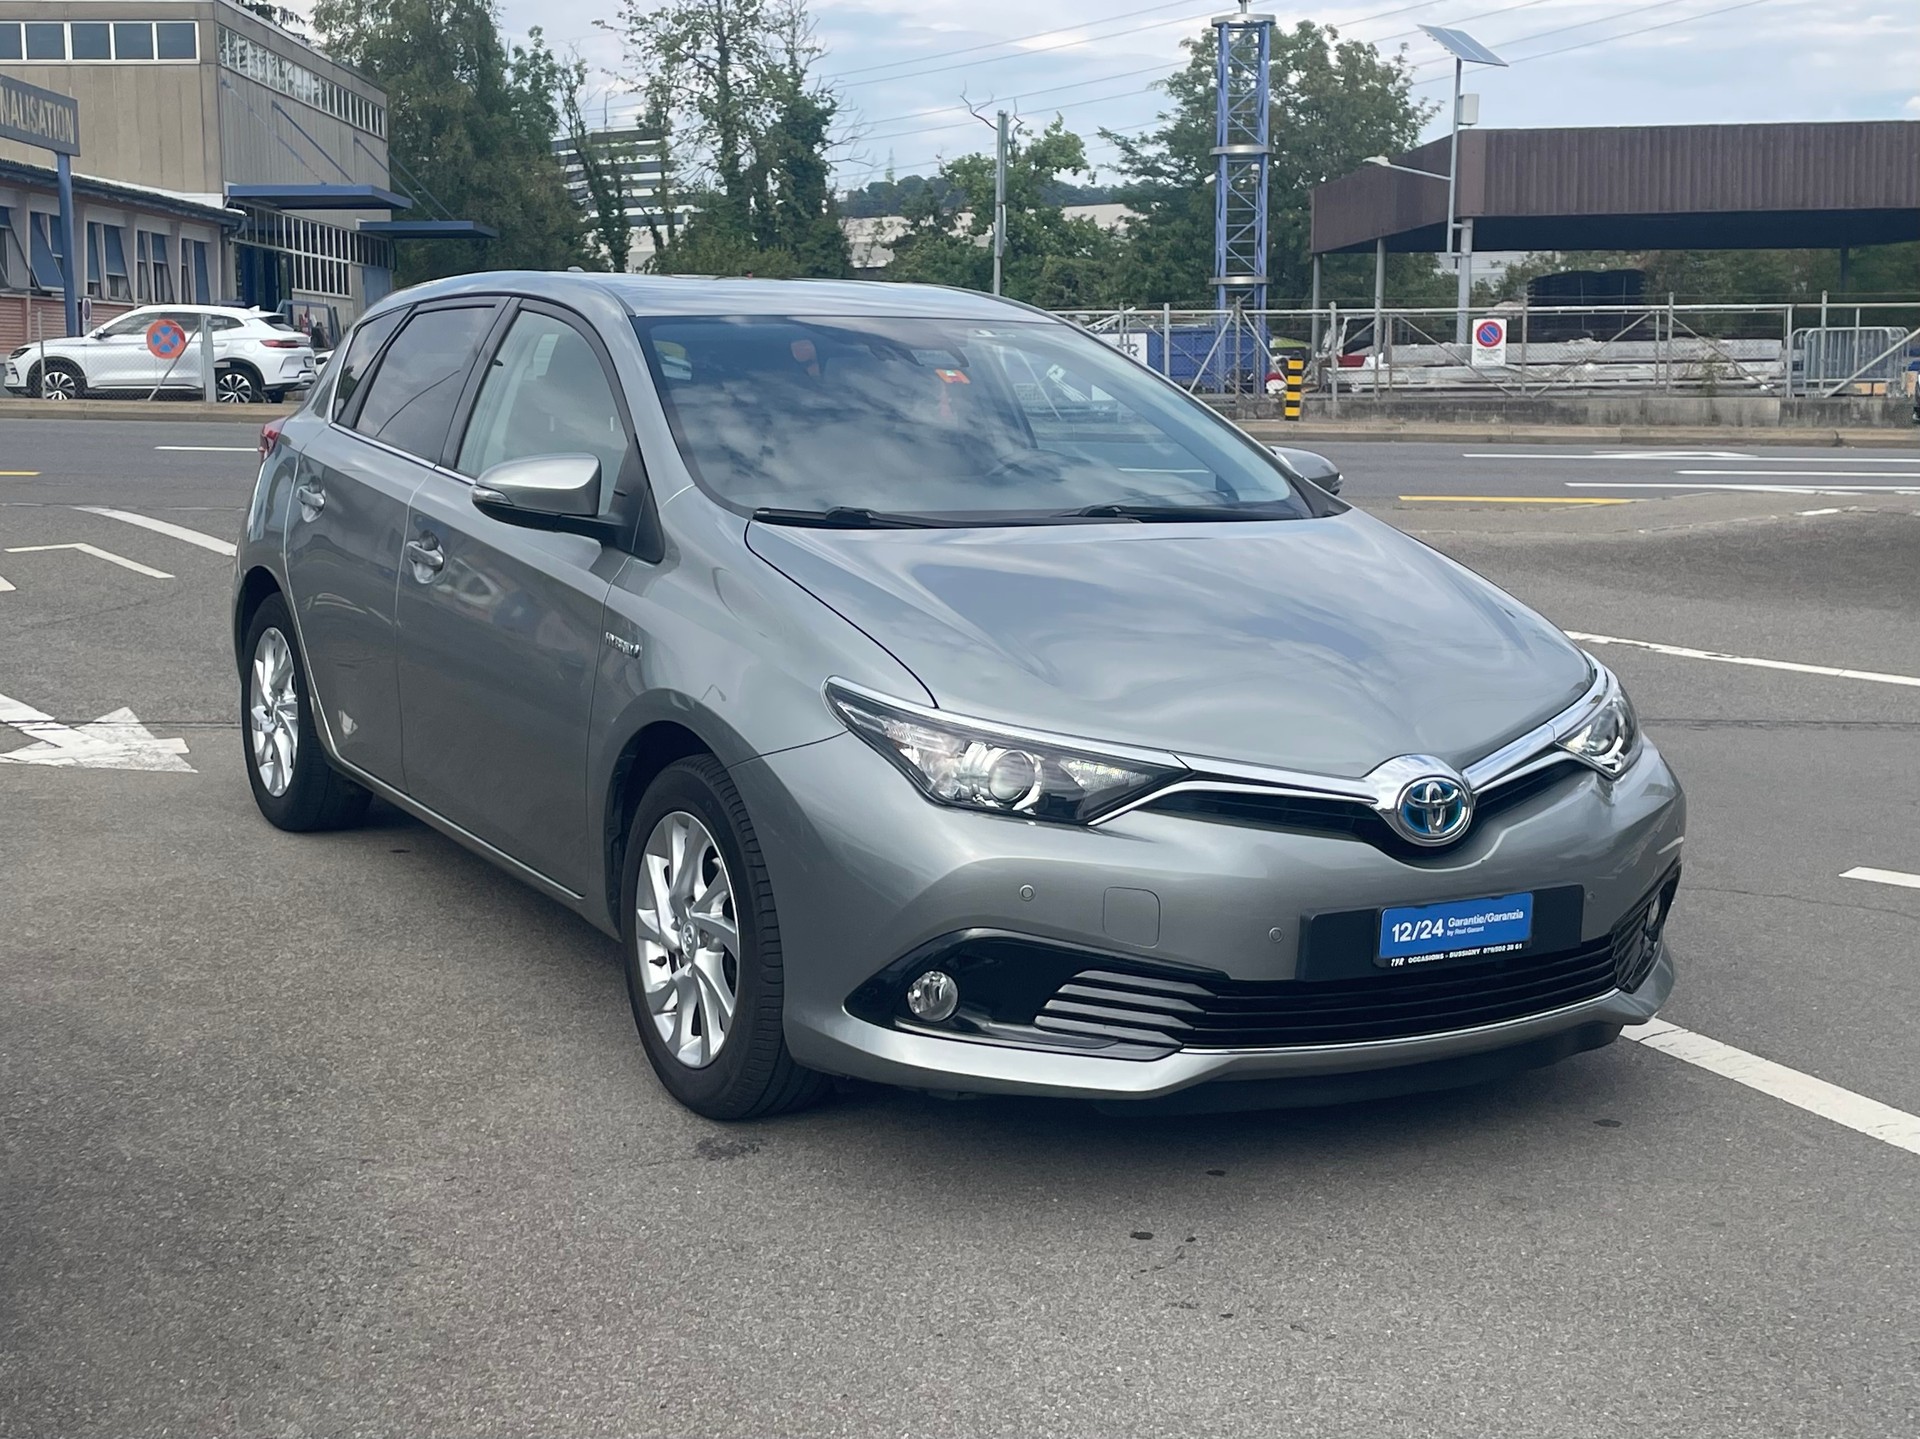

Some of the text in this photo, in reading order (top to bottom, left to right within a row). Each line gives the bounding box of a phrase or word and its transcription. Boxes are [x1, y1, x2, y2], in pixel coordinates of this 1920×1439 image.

[0, 85, 75, 145] NALISATION
[1448, 908, 1524, 928] Garantie/Garanzia
[1391, 918, 1444, 943] 12/24
[1407, 953, 1445, 964] OCCASIONS
